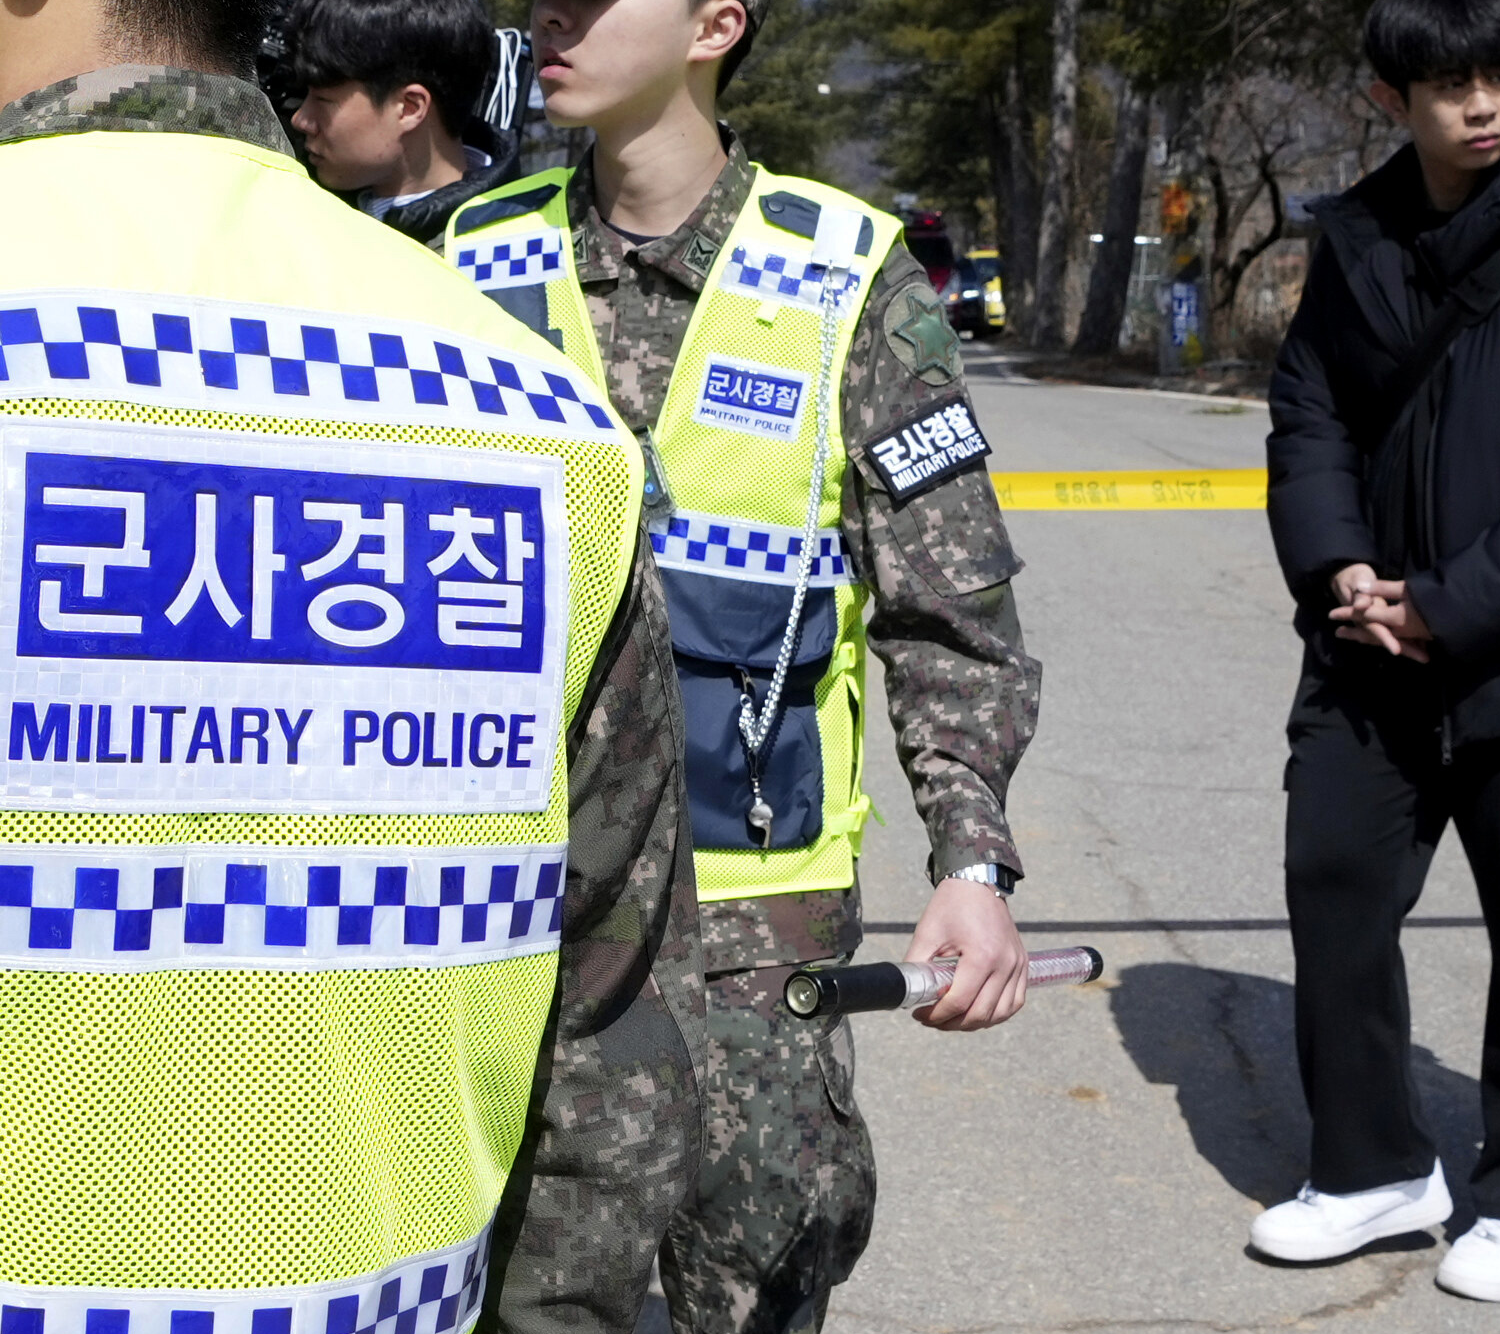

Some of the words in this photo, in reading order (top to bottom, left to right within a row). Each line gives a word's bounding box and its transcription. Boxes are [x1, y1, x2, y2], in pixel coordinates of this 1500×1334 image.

[708, 371, 798, 411] 군사경찰
[755, 419, 792, 434] POLICE
[872, 403, 976, 474] 군사경찰
[891, 450, 949, 491] MILITARY
[946, 433, 986, 464] POLICE
[35, 487, 535, 648] 군사경찰
[8, 700, 314, 766] MILITARY
[342, 709, 537, 768] POLICE
